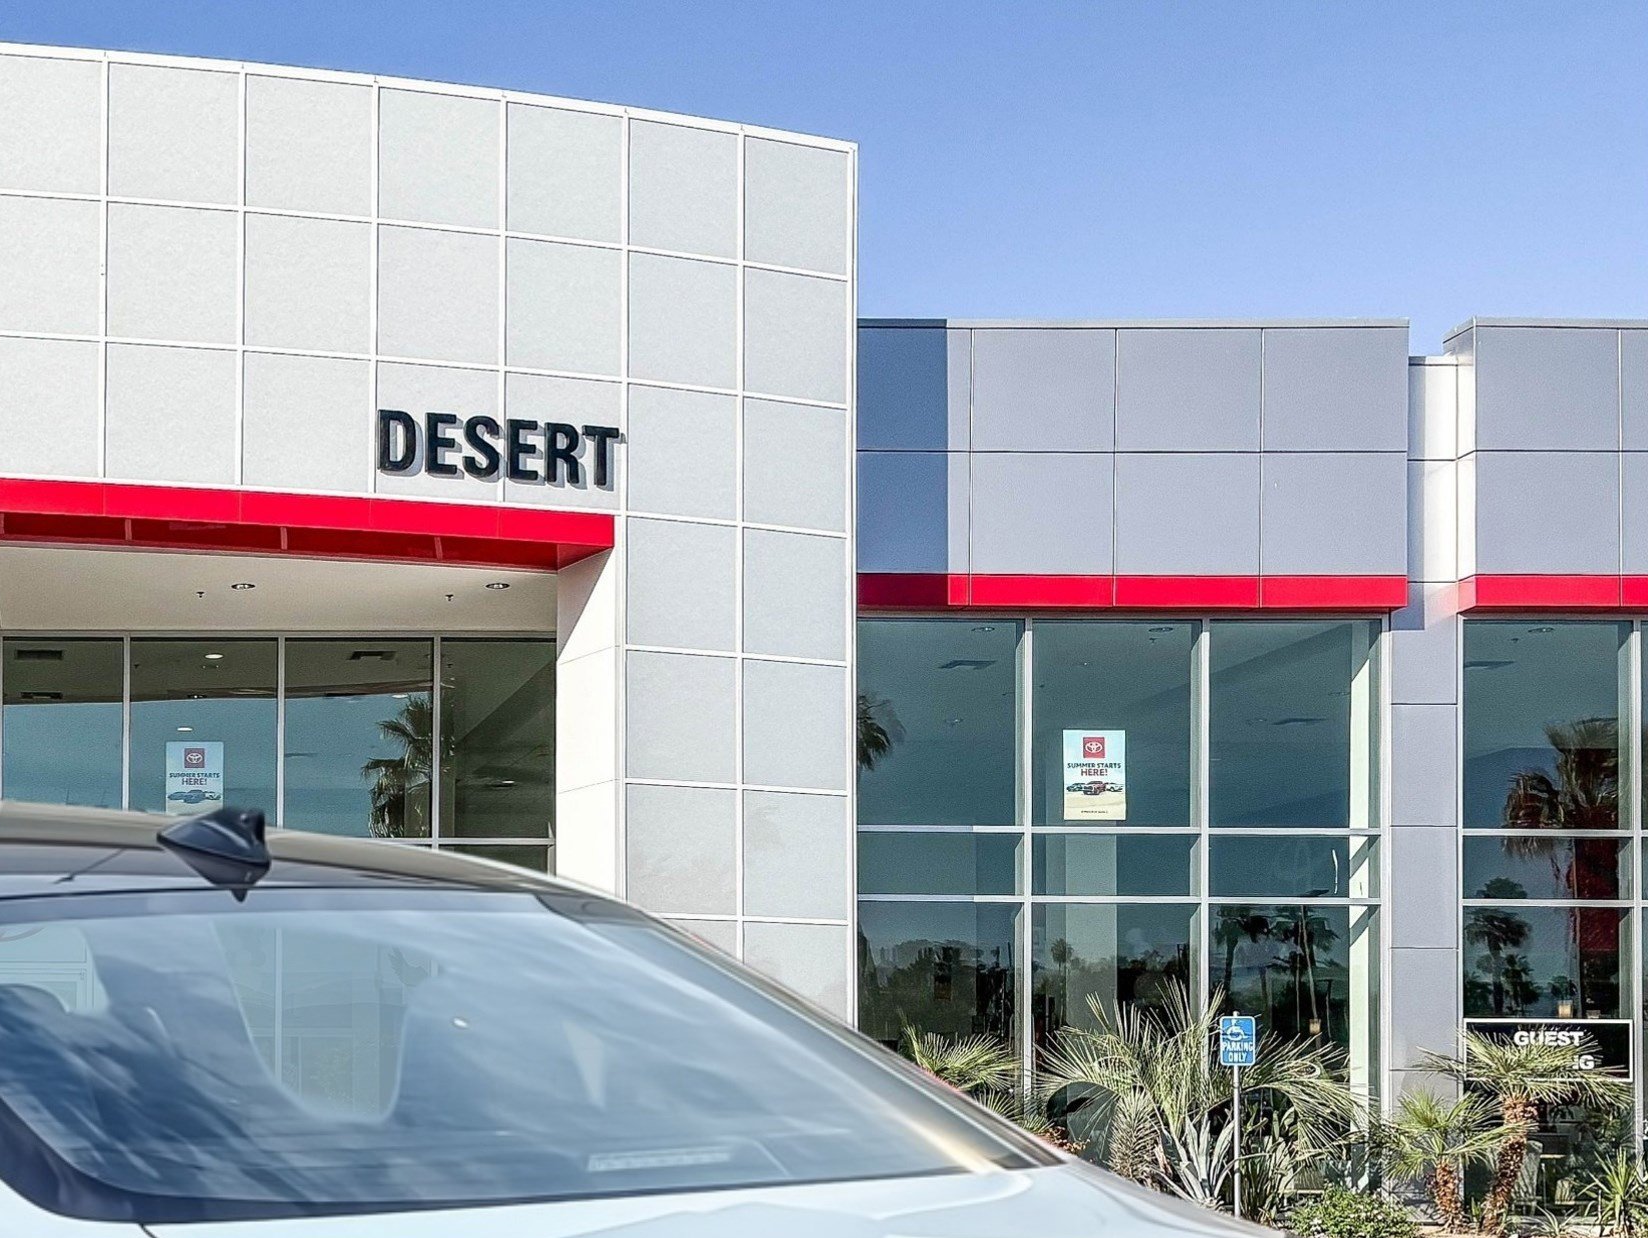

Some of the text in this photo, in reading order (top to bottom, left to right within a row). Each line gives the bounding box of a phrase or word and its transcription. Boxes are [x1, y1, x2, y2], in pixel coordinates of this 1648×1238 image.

[377, 409, 620, 486] DESERT
[1513, 1030, 1585, 1047] GUEST
[1222, 1041, 1254, 1052] PARKING
[1228, 1052, 1247, 1063] ONLY
